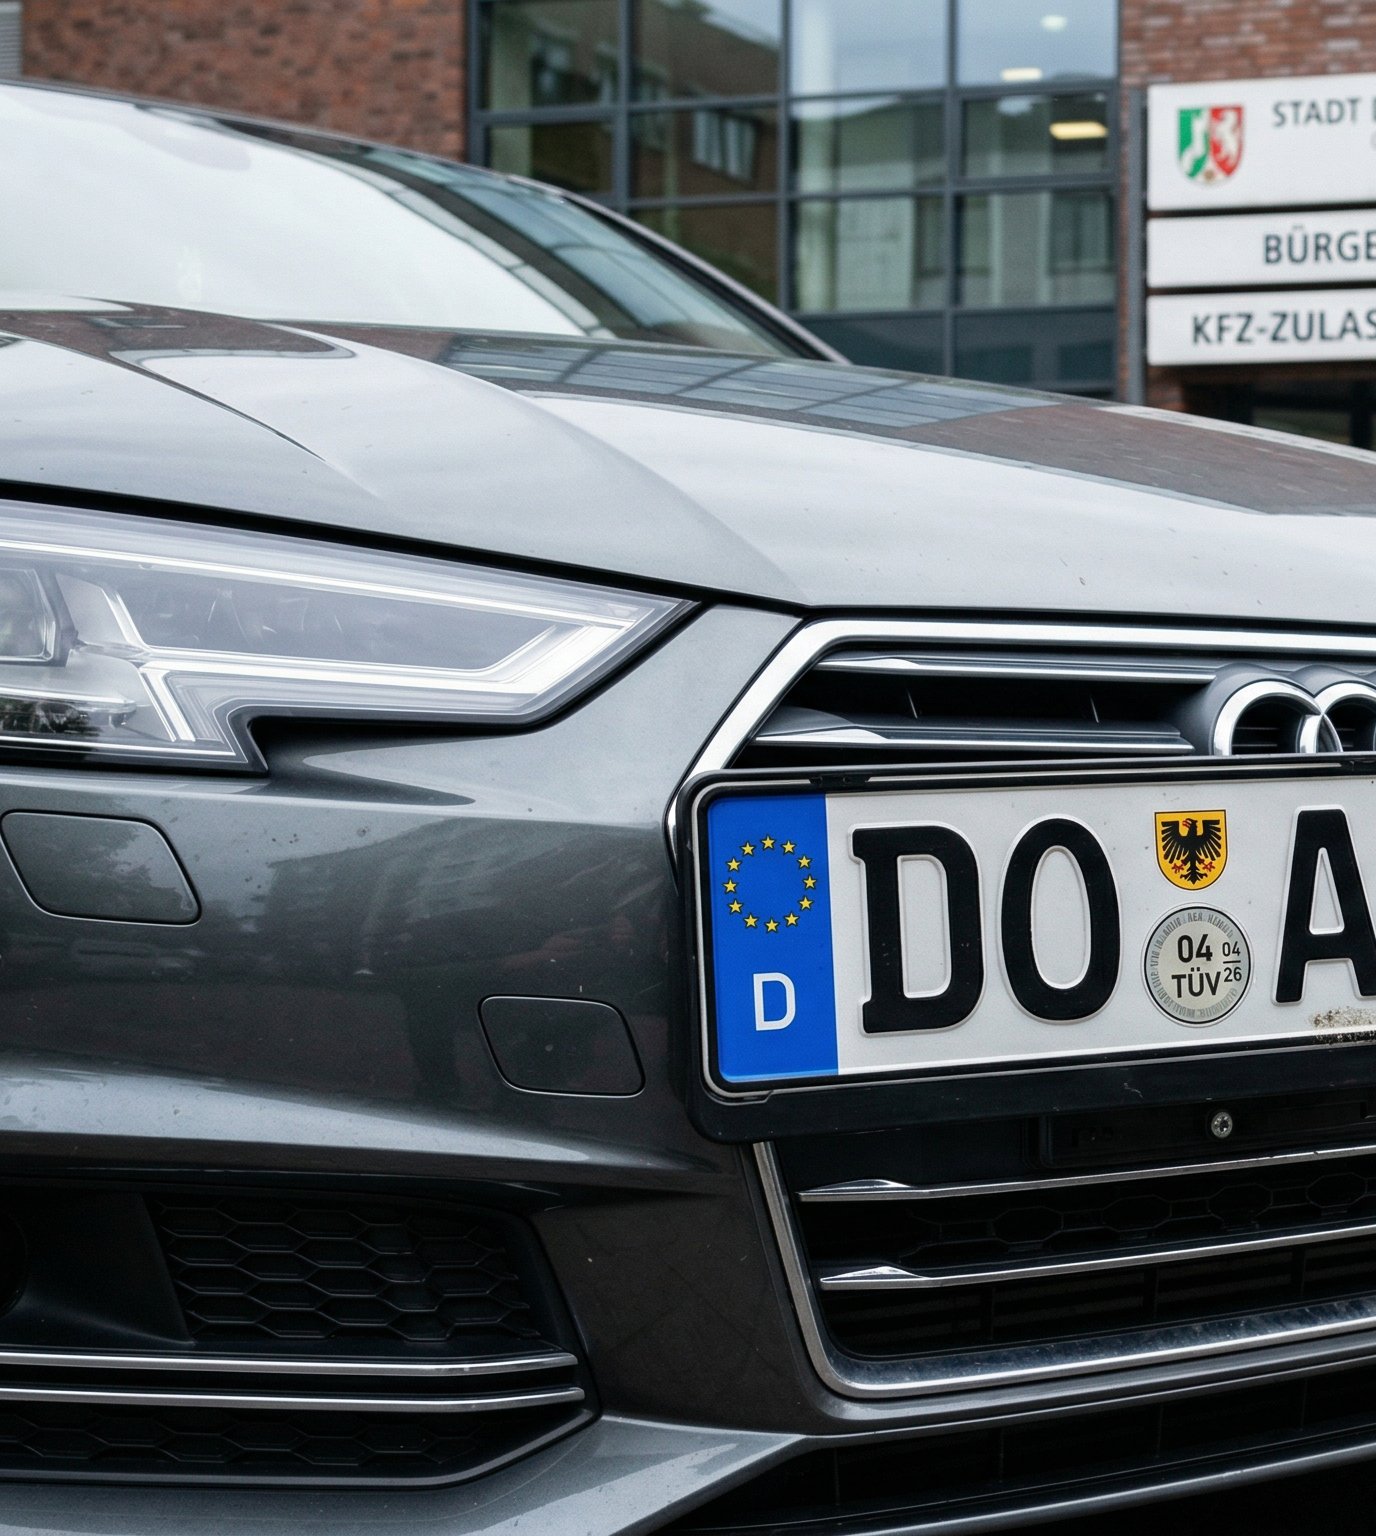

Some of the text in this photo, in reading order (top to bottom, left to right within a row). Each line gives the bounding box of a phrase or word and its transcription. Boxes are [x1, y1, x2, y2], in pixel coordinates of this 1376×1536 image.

[1272, 96, 1362, 127] STADT
[850, 816, 1122, 1034] DO
[1177, 933, 1214, 964] 04
[1222, 941, 1242, 957] 04
[1171, 966, 1222, 999] TÜV
[1223, 966, 1243, 983] 26
[752, 972, 797, 1032] D
